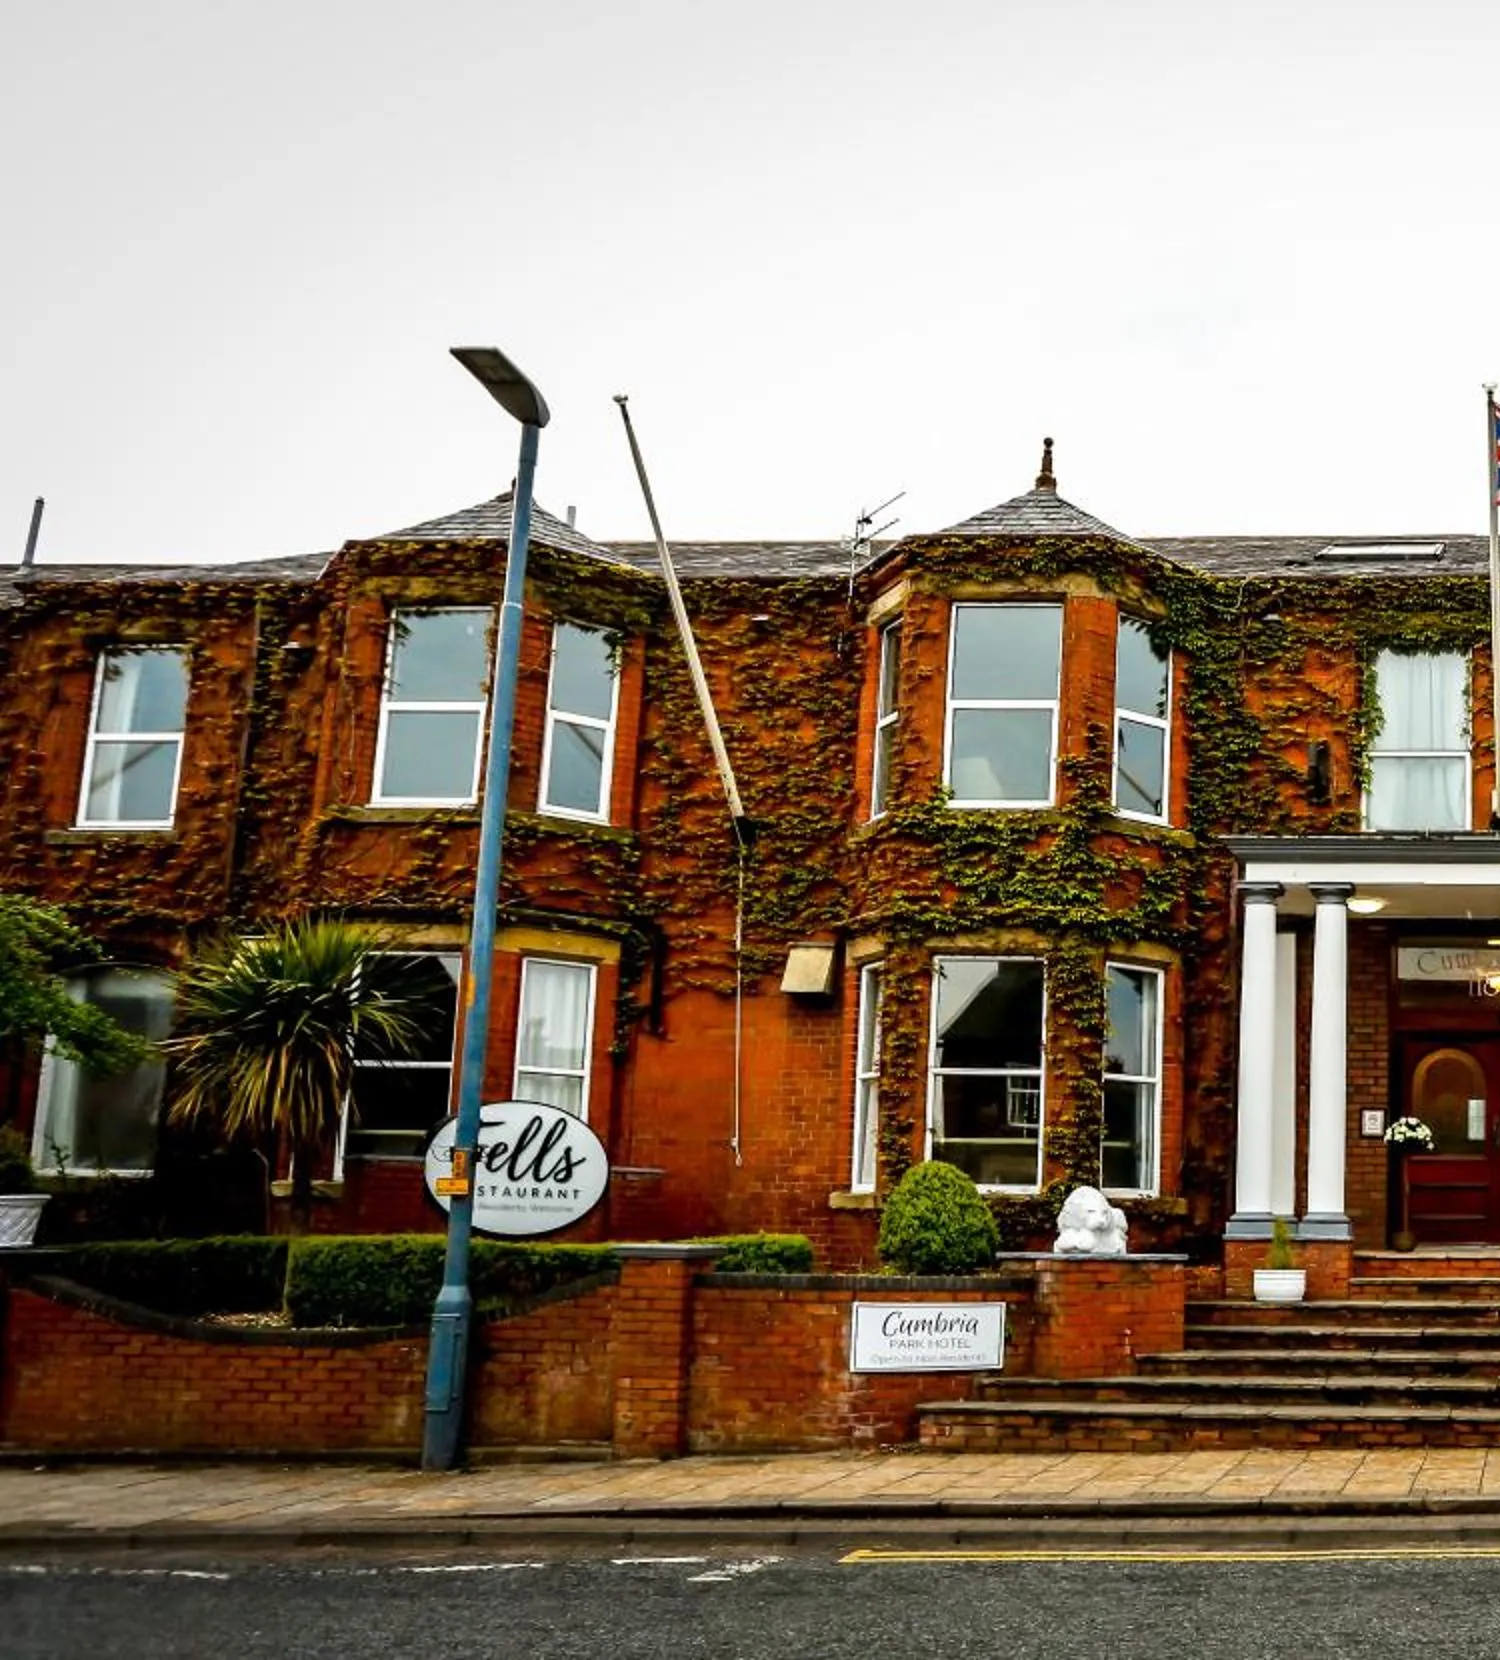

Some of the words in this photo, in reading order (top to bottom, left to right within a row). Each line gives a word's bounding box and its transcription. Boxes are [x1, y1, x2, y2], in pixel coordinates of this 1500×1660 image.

[476, 1185, 582, 1200] STAURANT
[881, 1311, 979, 1337] Cumbria
[889, 1339, 925, 1350] PARK
[927, 1338, 972, 1349] HOTEL
